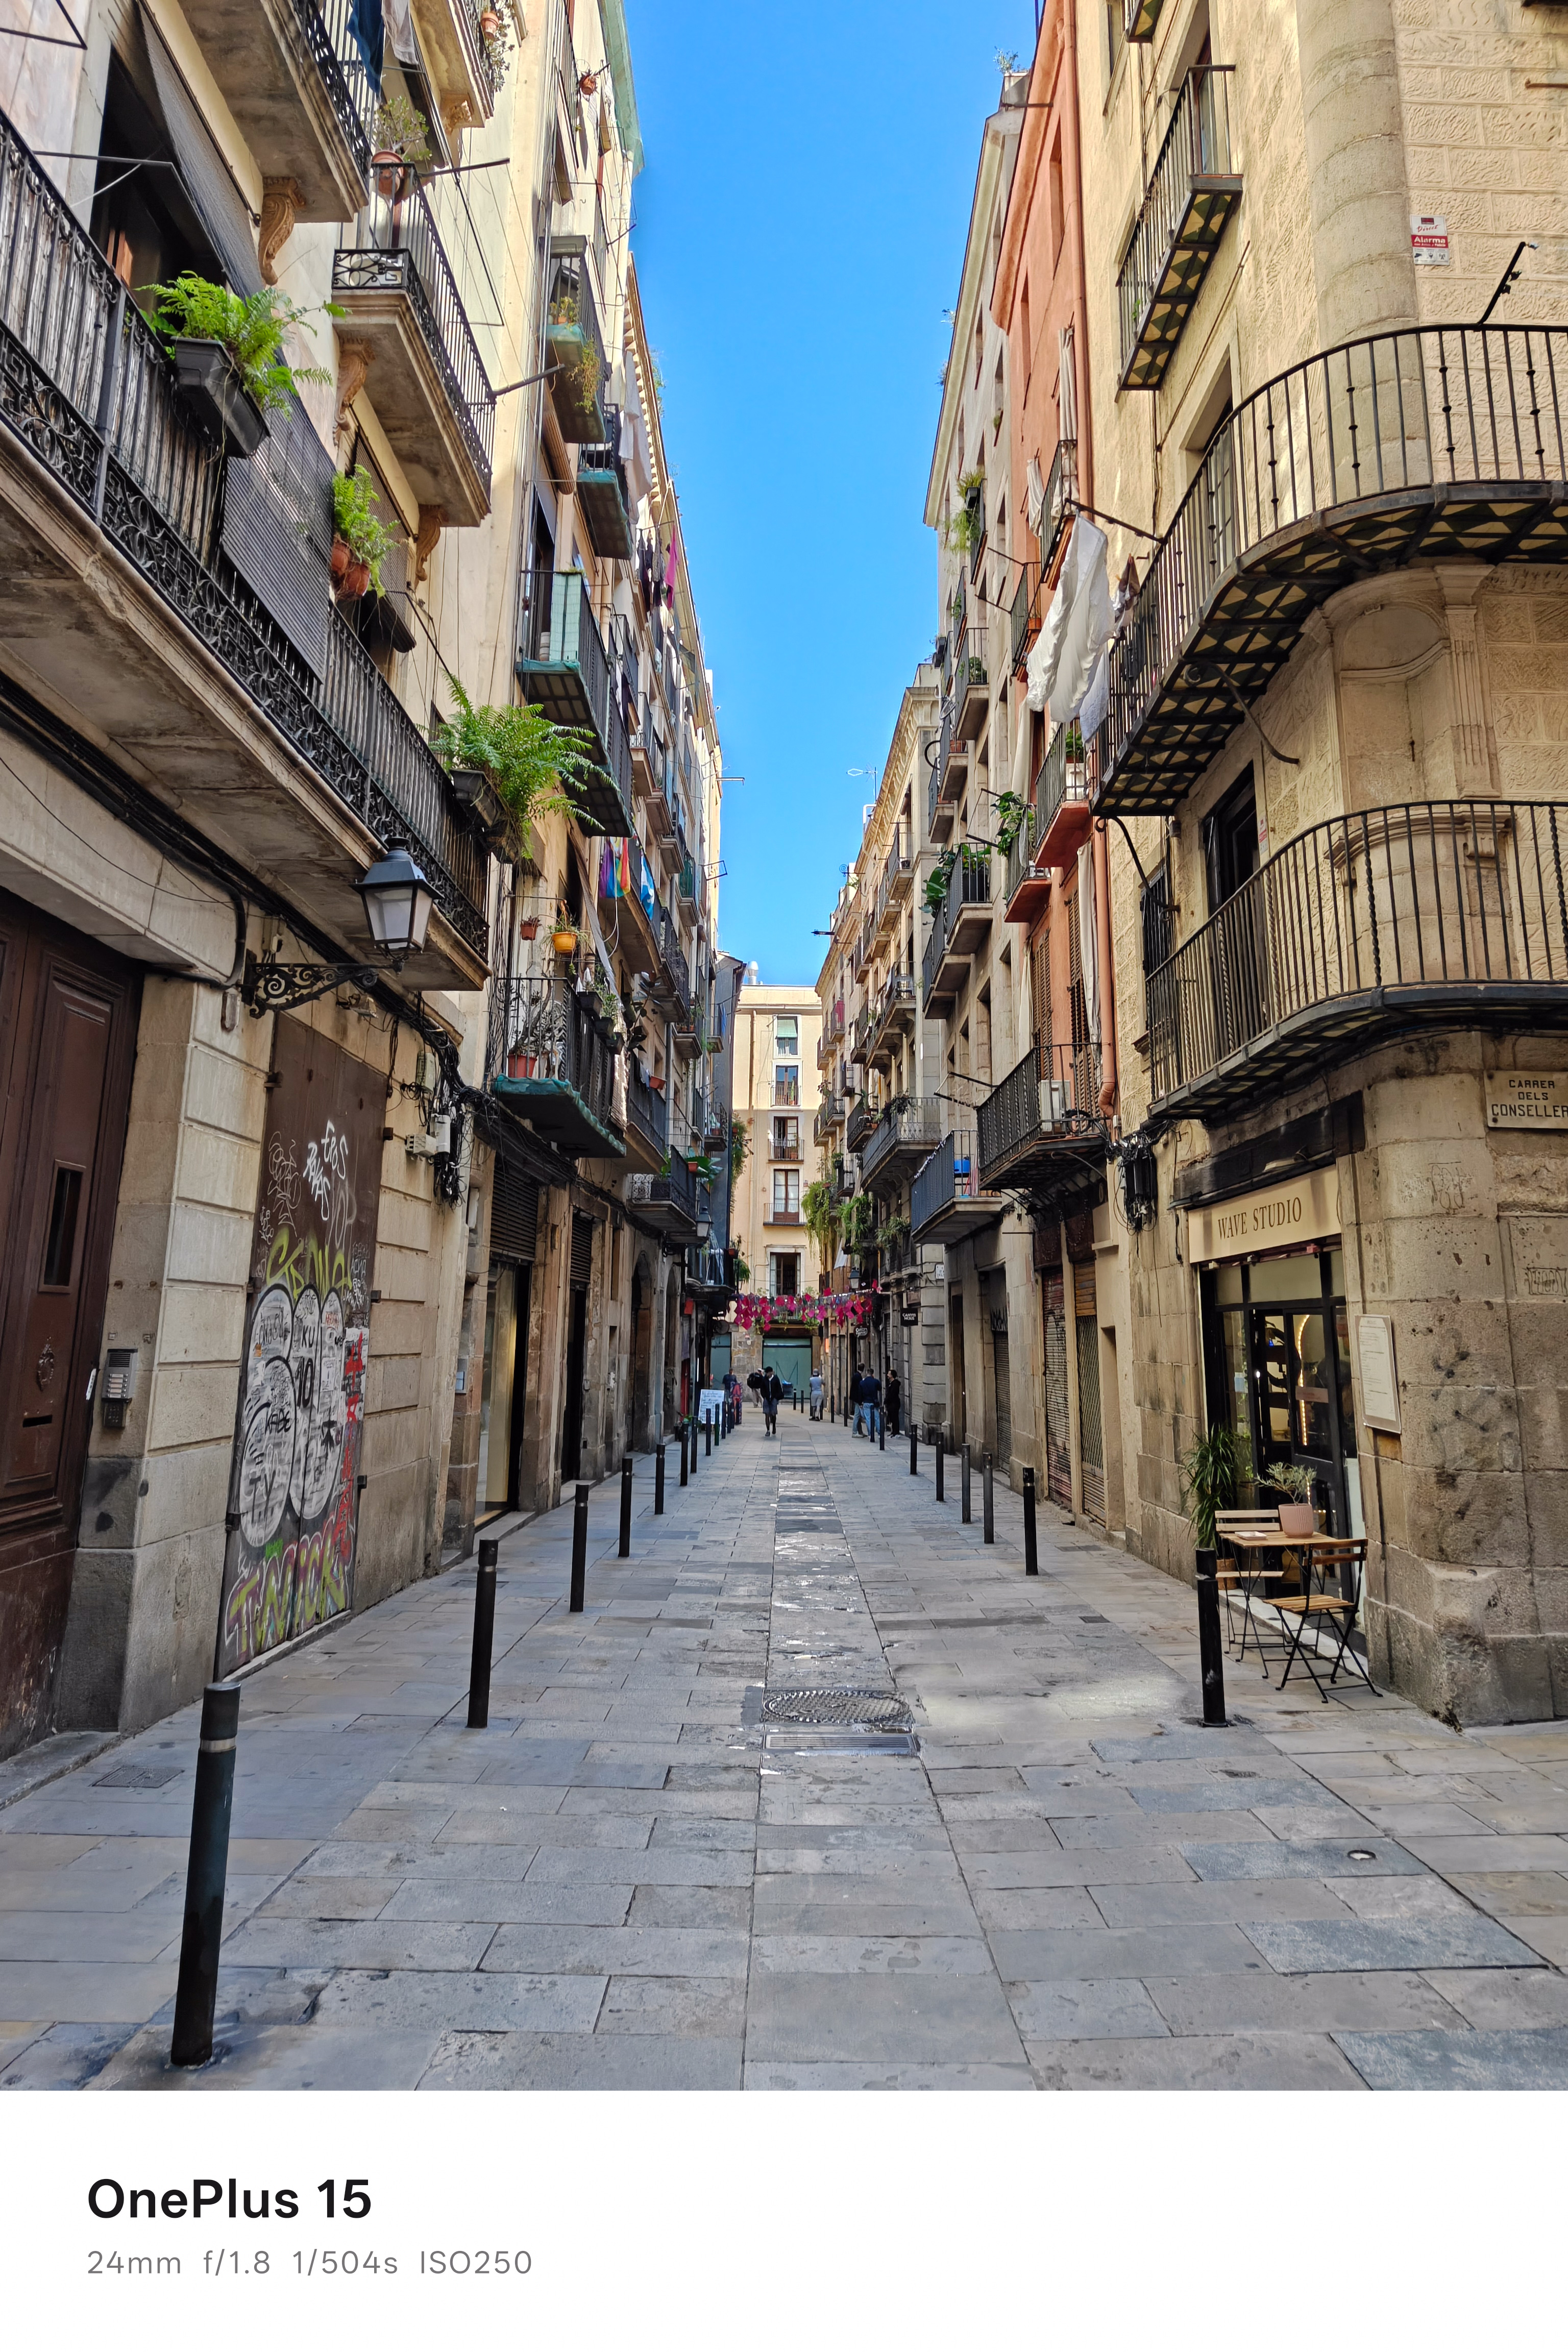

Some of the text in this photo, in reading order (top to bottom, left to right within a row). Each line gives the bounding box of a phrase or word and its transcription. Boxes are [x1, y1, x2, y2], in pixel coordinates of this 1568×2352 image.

[1509, 1080, 1555, 1089] CARRER
[1518, 1092, 1549, 1100] DELS
[1491, 1104, 1568, 1118] CONSELLER
[1218, 1197, 1302, 1240] WAVE STUDIO
